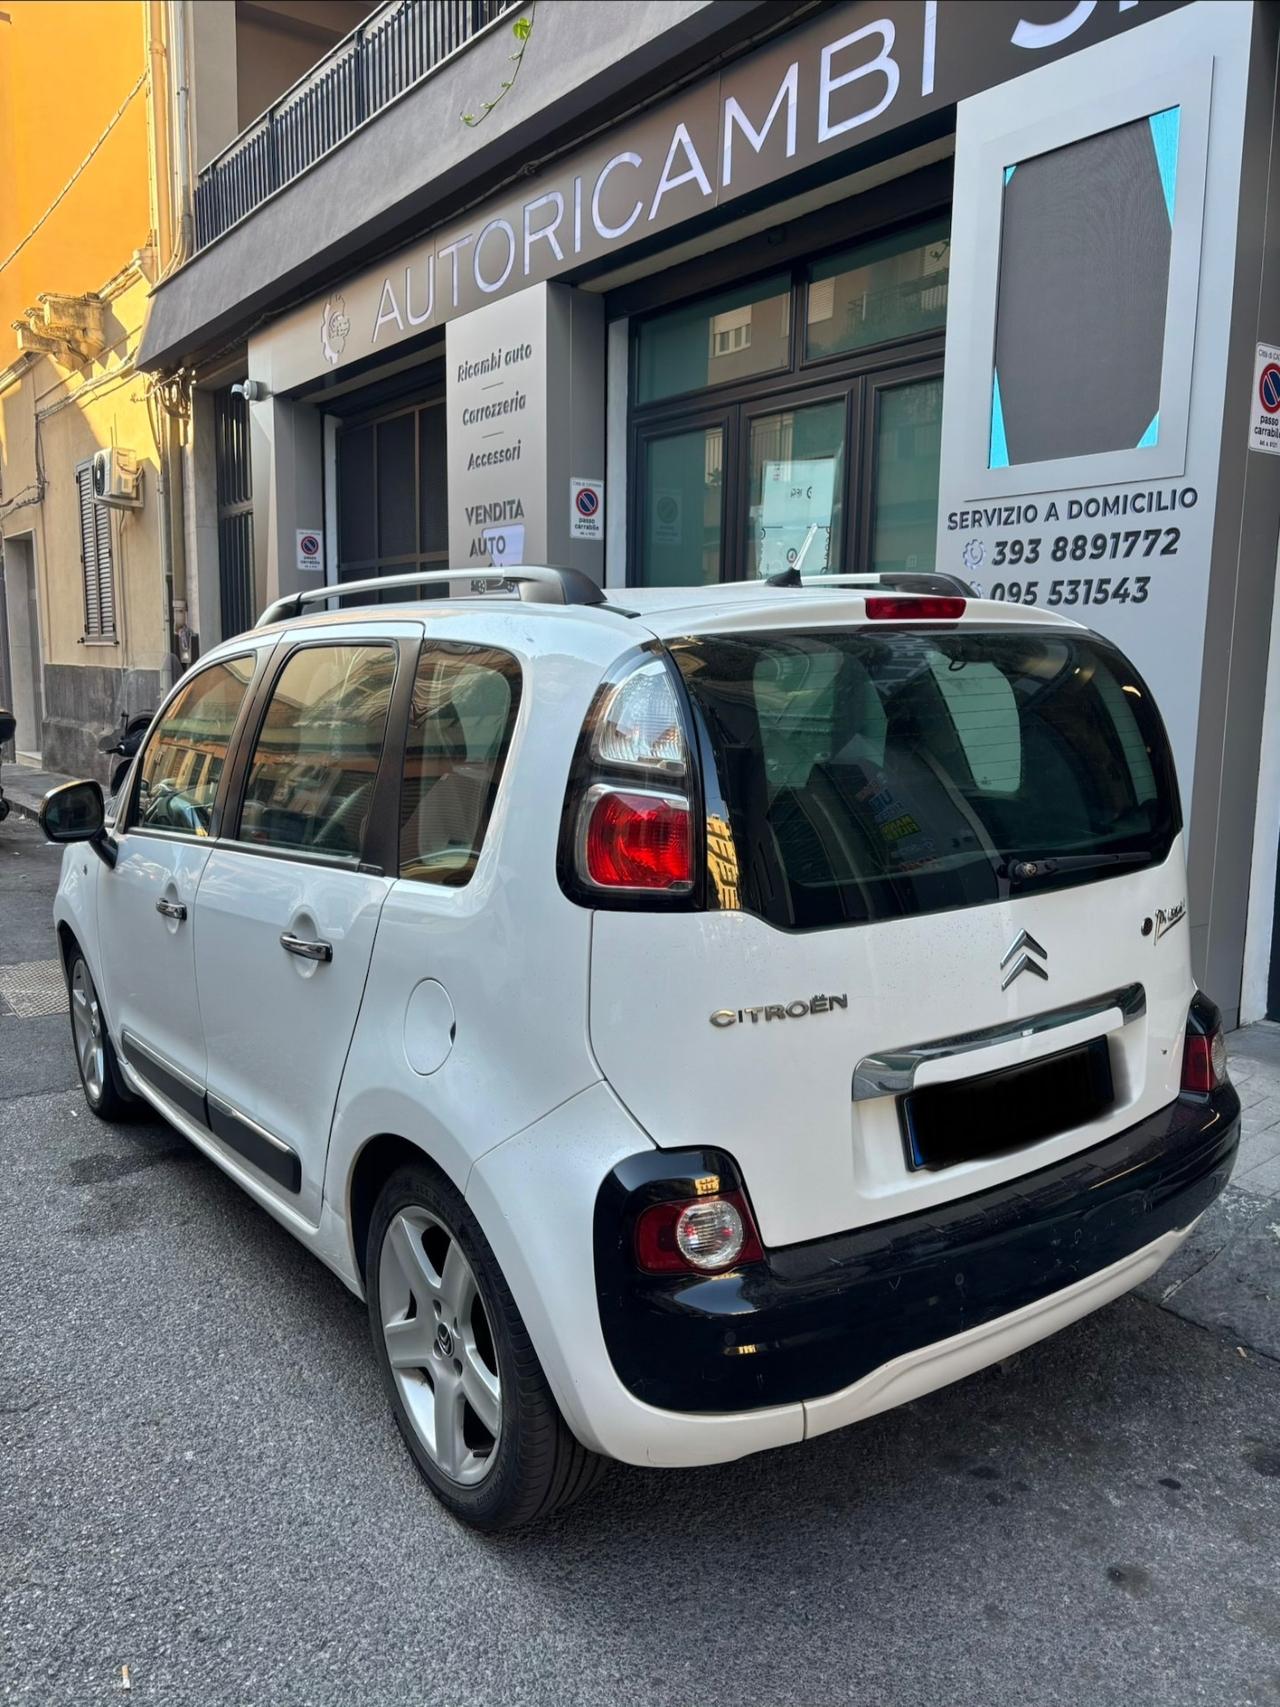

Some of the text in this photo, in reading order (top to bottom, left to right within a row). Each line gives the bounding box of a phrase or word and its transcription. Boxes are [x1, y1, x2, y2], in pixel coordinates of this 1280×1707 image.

[372, 0, 937, 344] AUTORICAMBI
[457, 343, 533, 383] Ricambi auto
[462, 391, 527, 426] Carrozzeria
[1260, 415, 1279, 426] passo
[467, 440, 521, 471] Accessori
[465, 499, 525, 526] VENDITA
[947, 487, 1198, 531] SERVIZIO A DOMICILIO
[469, 535, 506, 558] AUTO
[991, 527, 1181, 566] 393 8891772
[989, 576, 1151, 607] 095 531543
[709, 993, 848, 1028] CITROËN
